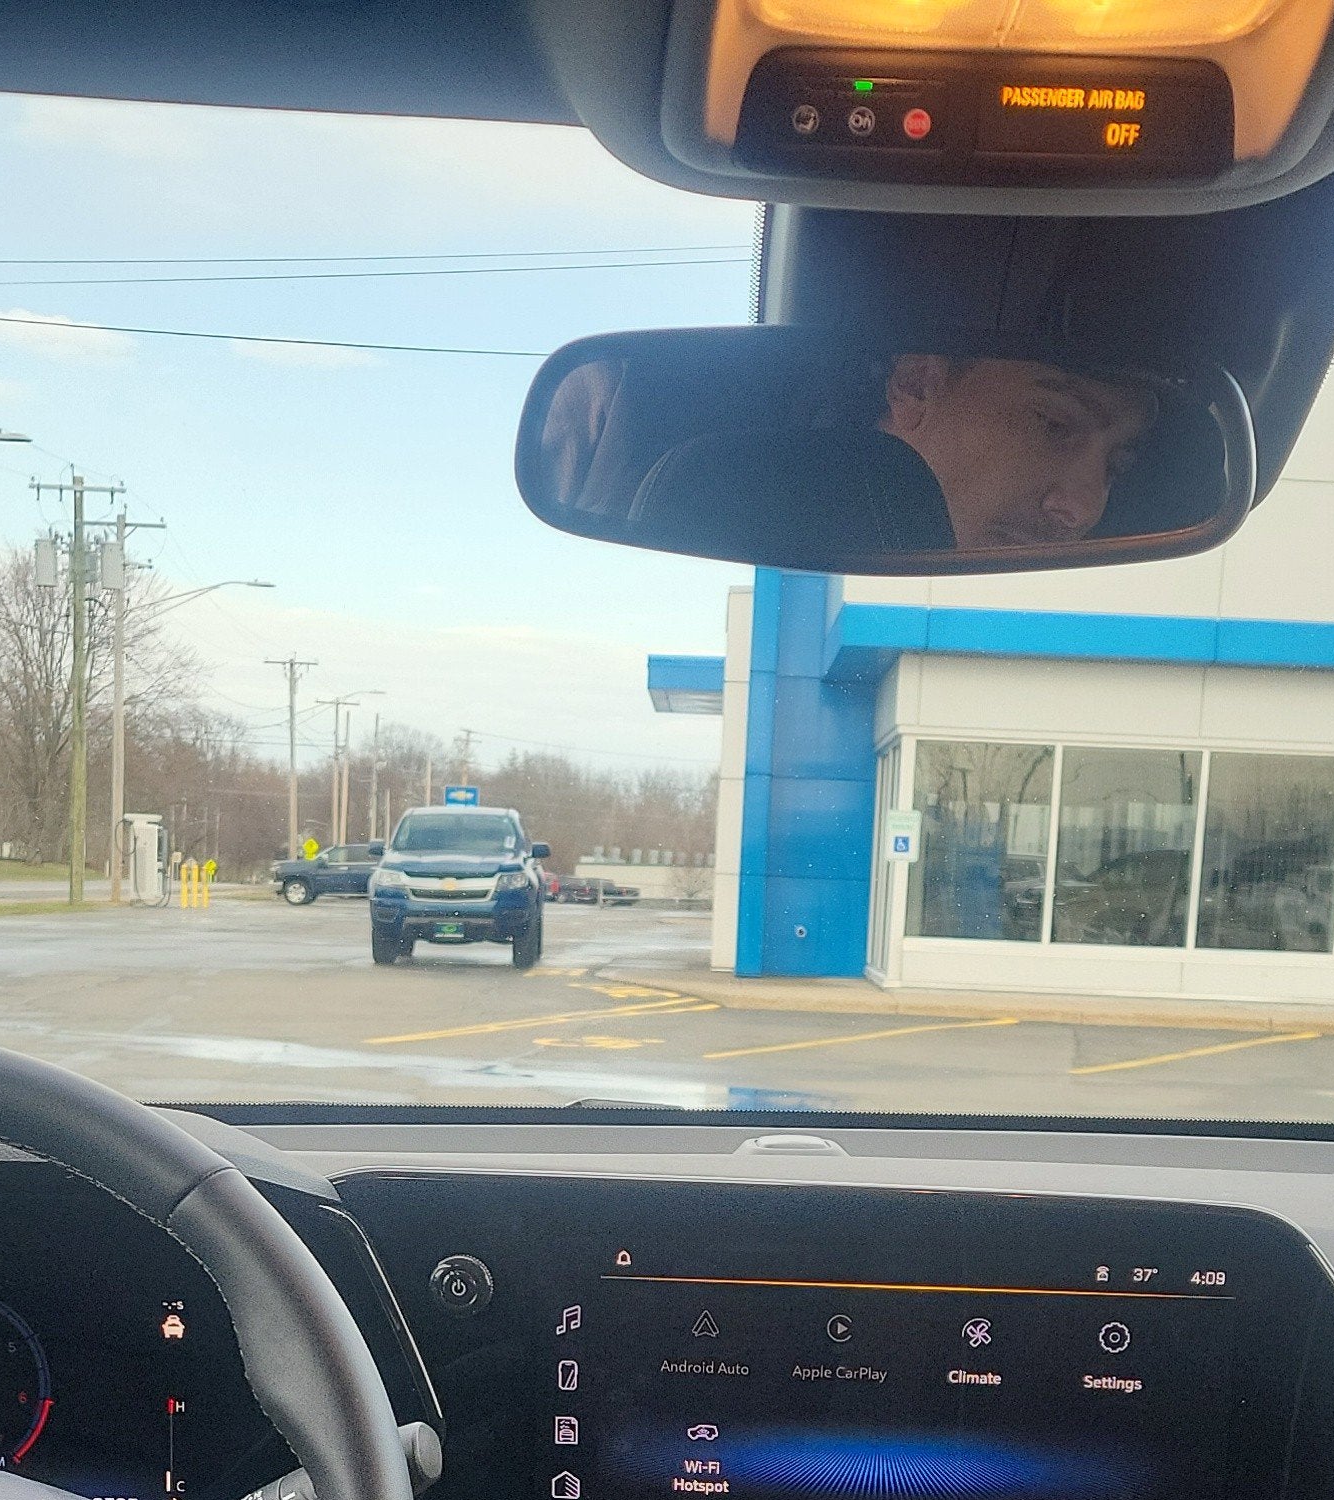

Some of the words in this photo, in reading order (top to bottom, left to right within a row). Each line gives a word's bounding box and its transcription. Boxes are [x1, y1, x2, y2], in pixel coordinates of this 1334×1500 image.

[1001, 86, 1085, 109] PASSENGER
[1088, 89, 1113, 109] AIR
[1113, 90, 1145, 110] BAG
[1105, 122, 1141, 146] OFF
[1190, 1271, 1227, 1286] 4:09
[8, 1341, 17, 1353] 5
[660, 1358, 713, 1376] Android
[717, 1361, 750, 1377] Auto
[792, 1363, 833, 1384] Apple
[835, 1365, 888, 1384] CarPlay
[948, 1369, 1002, 1386] Climate
[1083, 1375, 1143, 1394] Settings
[19, 1392, 28, 1404] 6
[175, 1401, 185, 1413] H
[684, 1460, 721, 1476] Wi-Fi
[176, 1481, 185, 1492] C
[673, 1478, 730, 1496] Hotspot
